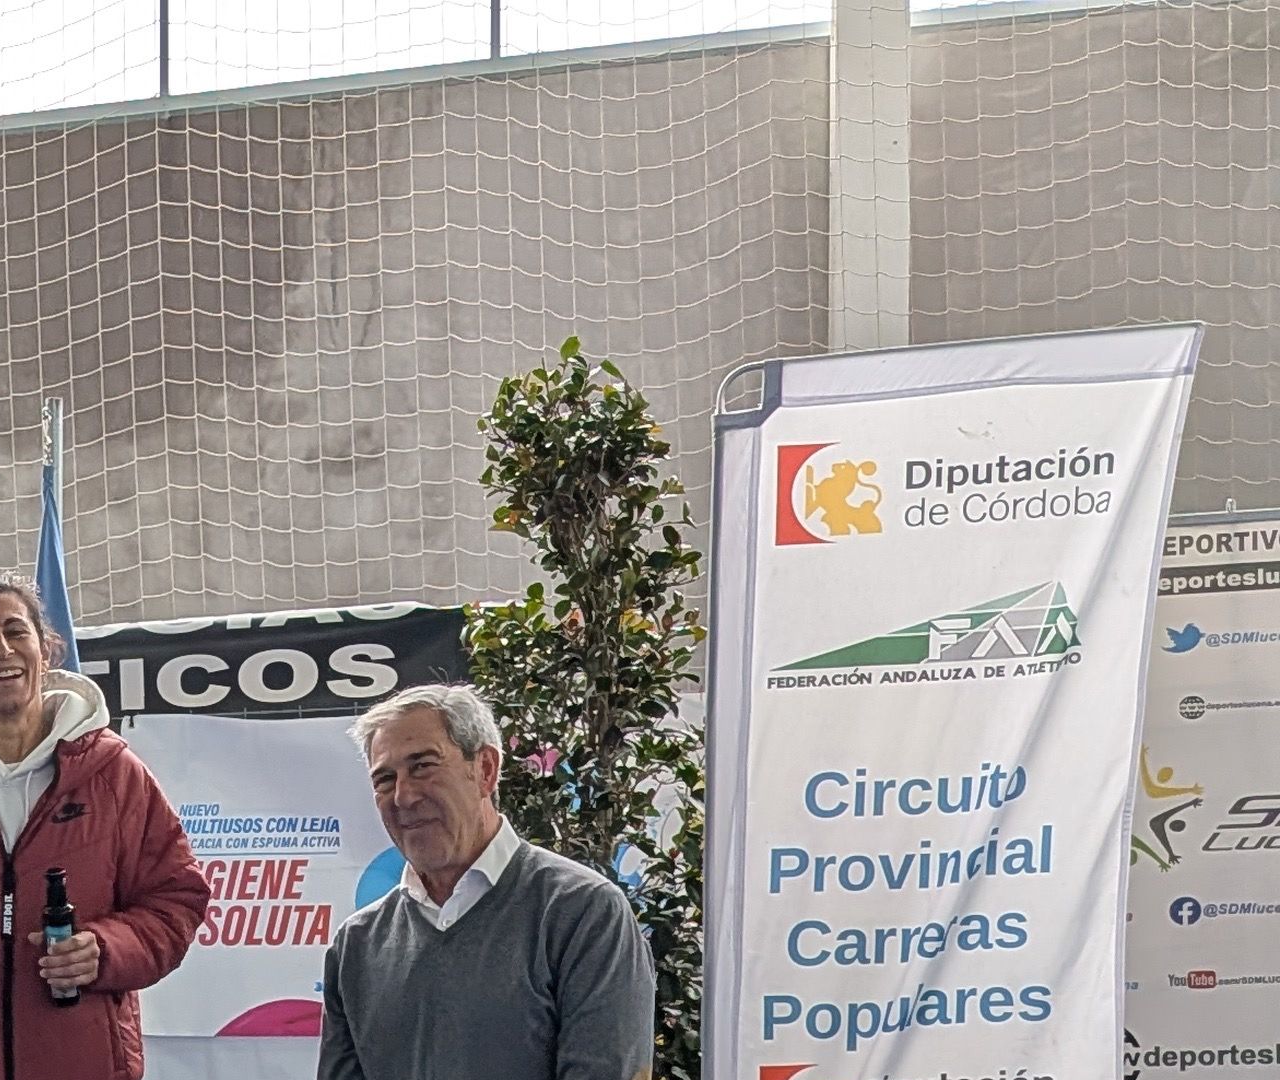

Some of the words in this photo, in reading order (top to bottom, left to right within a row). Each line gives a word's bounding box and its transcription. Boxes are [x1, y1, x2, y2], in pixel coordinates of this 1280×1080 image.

[904, 447, 1115, 493] Diputación
[904, 498, 950, 528] de
[961, 486, 1112, 524] Córdoba
[1163, 529, 1280, 556] EPORTIV
[1159, 568, 1280, 593] eporteslu
[767, 667, 872, 689] FEDERACIÓN
[879, 667, 976, 684] ANDALUZA
[983, 665, 1006, 678] DE
[803, 763, 1027, 819] Circuito
[179, 804, 220, 816] NUEVO
[266, 818, 298, 833] CON
[301, 816, 340, 832] LEJÍA
[191, 838, 223, 849] CACIA
[225, 837, 248, 848] CON
[251, 836, 298, 849] ESPUMA
[301, 836, 341, 848] ACTIVA
[769, 825, 1053, 894] Provincial
[198, 904, 332, 947] SOLUTA
[1203, 903, 1280, 918] @SDMluce
[787, 911, 1028, 967] Carreras
[762, 983, 1053, 1052] Populares
